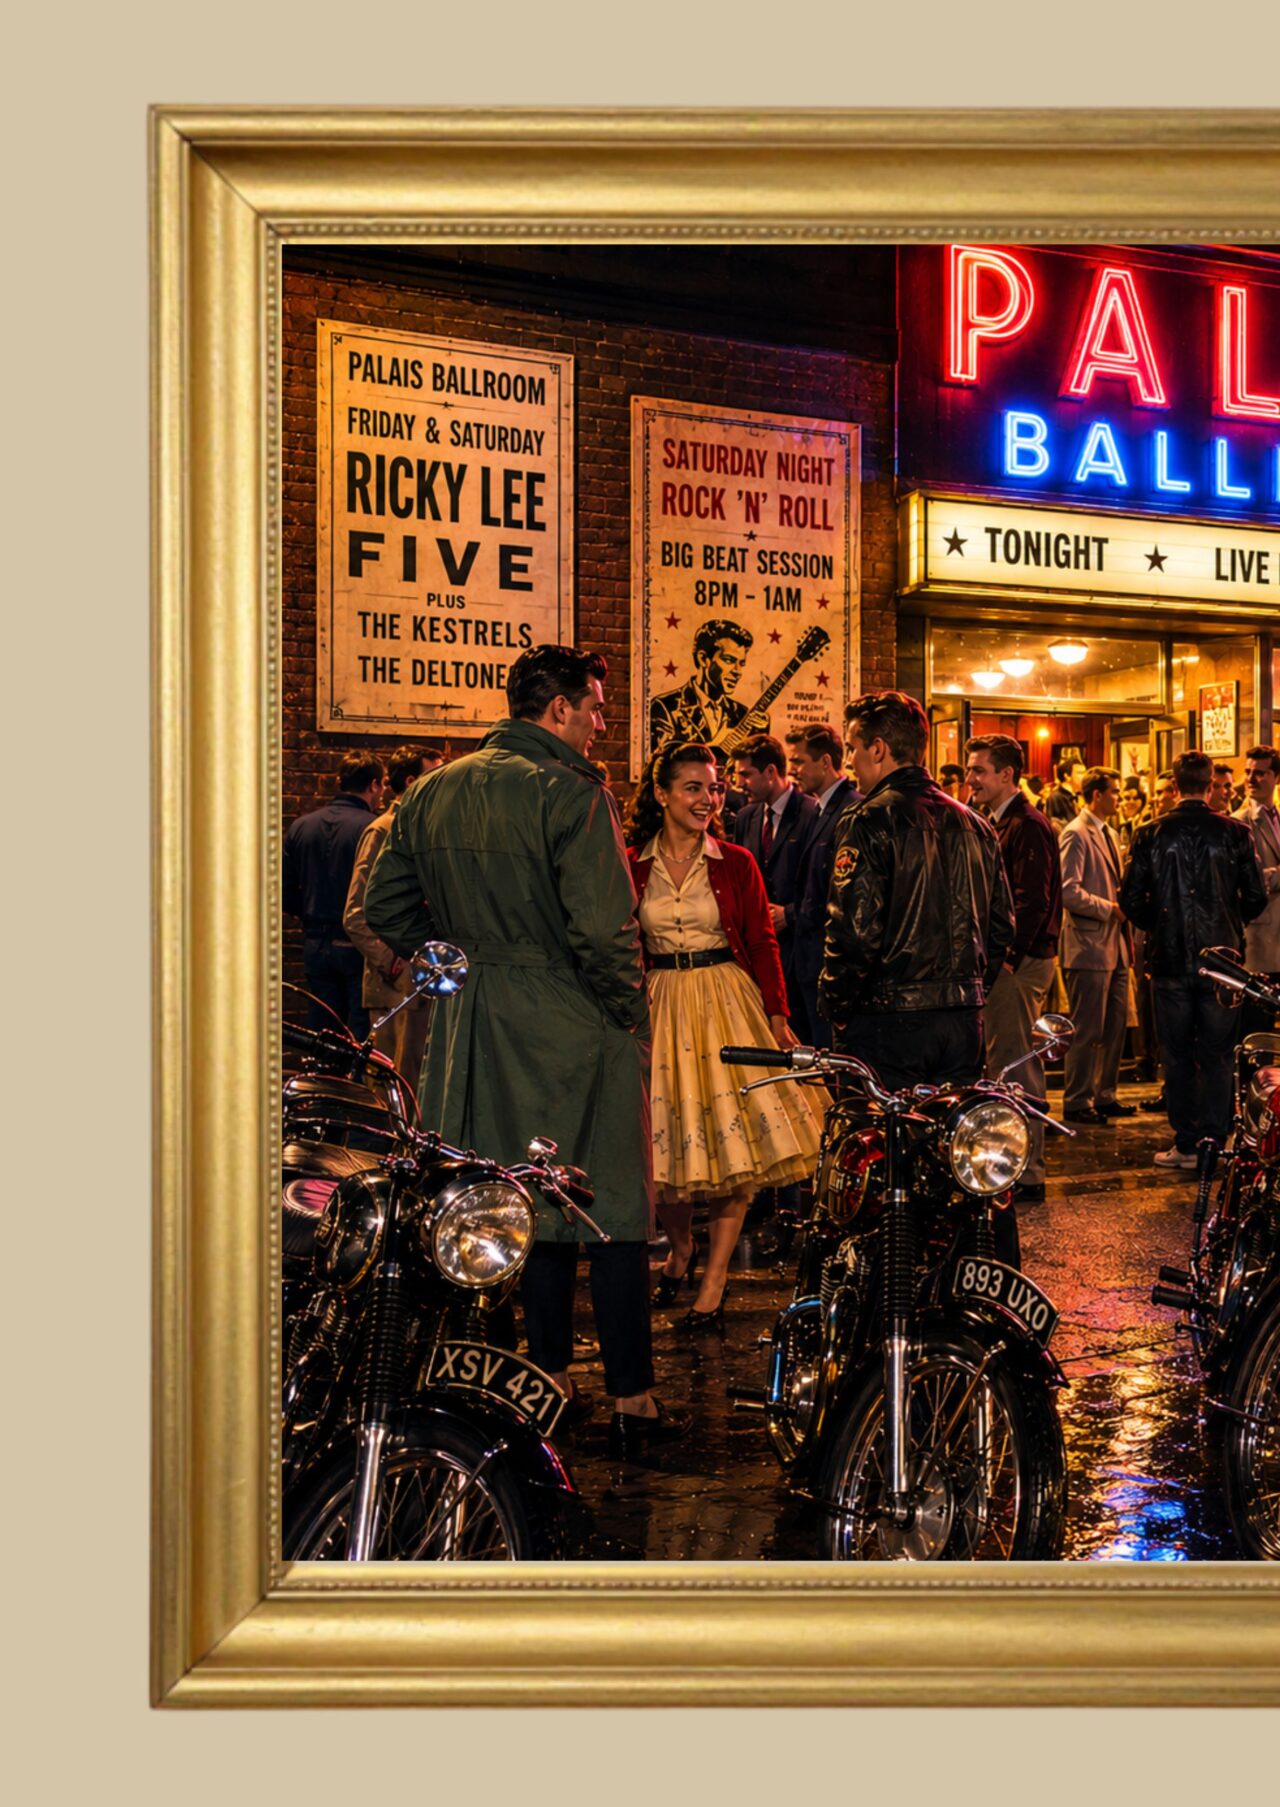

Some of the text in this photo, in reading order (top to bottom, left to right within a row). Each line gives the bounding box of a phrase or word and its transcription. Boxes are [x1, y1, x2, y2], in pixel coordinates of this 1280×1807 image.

[348, 350, 546, 406] PALAIS BALLROOM
[347, 406, 545, 457] FRIDAY & SATURDAY
[662, 437, 835, 487] SATURDAY NIGHT
[347, 450, 547, 532] RICKY LEE
[661, 481, 726, 521] ROCK
[779, 494, 834, 531] ROLL
[348, 530, 533, 592] FIVE
[661, 540, 834, 580] BIG BEAT SESSION
[984, 526, 1109, 572] TONIGHT
[1214, 546, 1270, 585] LIVE
[427, 592, 466, 610] PLUS
[694, 579, 738, 609] 8PM
[763, 585, 802, 612] 1AM
[357, 611, 532, 649] THE KESTRELS
[357, 655, 510, 690] THE DELTONE
[962, 1262, 1049, 1331] 893 UXO
[436, 1346, 555, 1421] XSV 421
